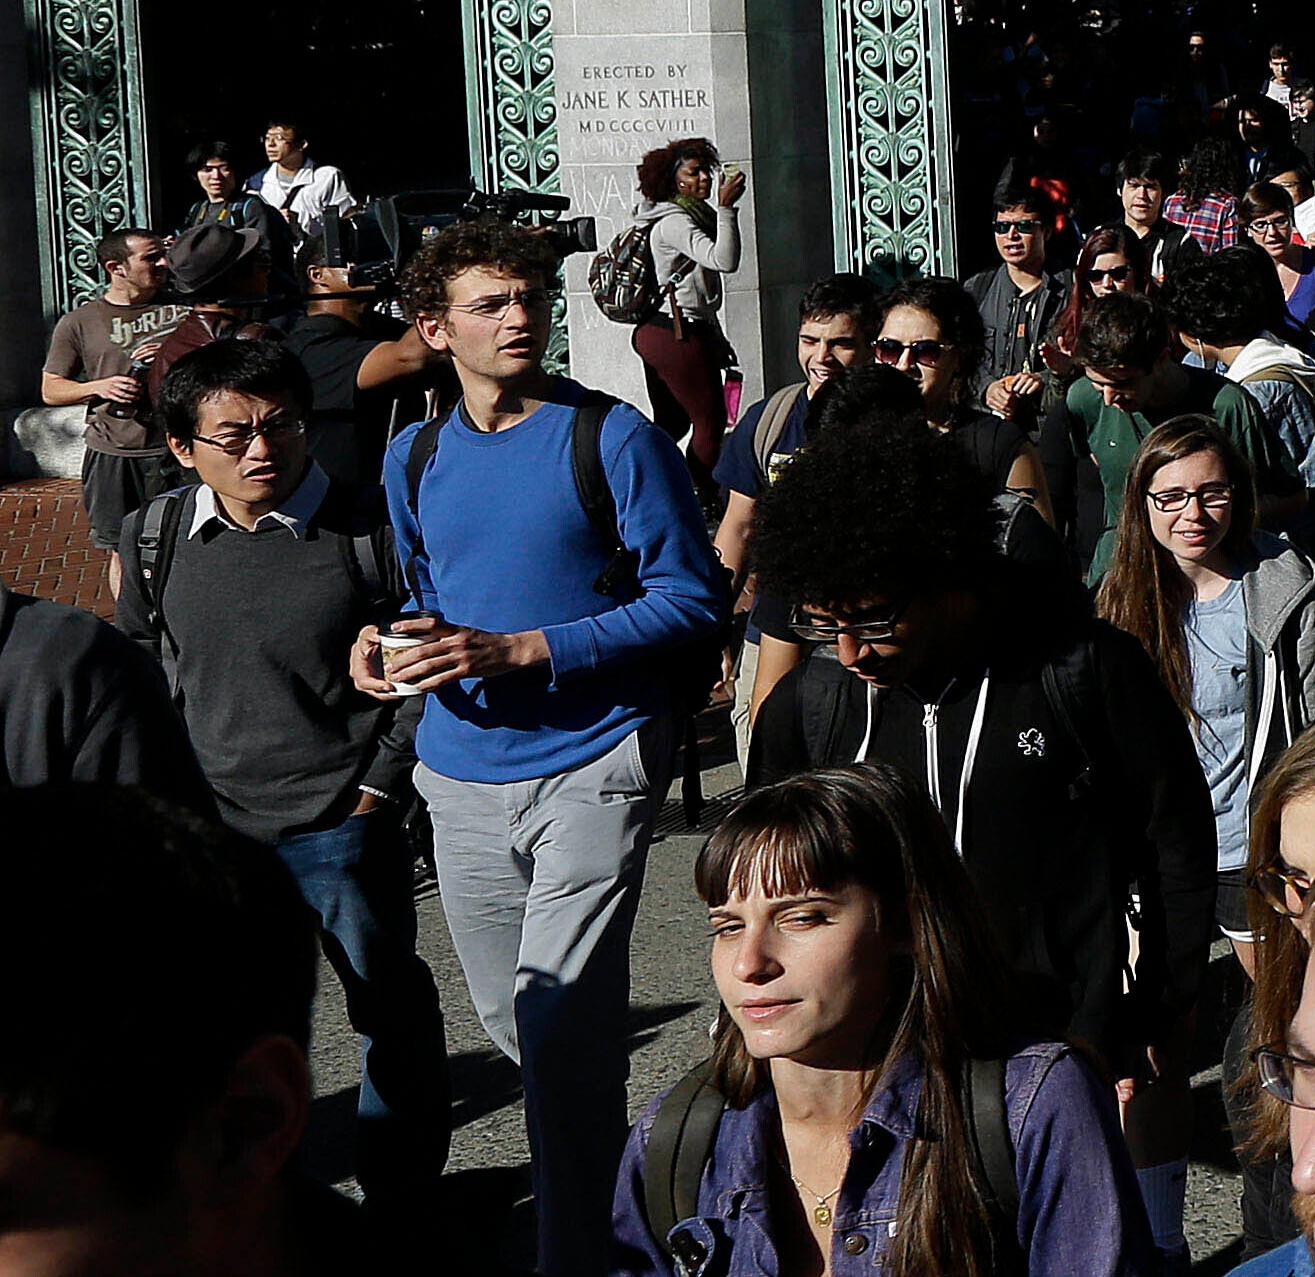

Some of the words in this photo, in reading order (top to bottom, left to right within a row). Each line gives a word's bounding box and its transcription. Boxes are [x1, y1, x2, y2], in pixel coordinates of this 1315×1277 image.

[583, 65, 655, 79] ERECTED
[667, 64, 687, 78] BY
[562, 90, 609, 110] JANE
[617, 90, 631, 109] K
[638, 89, 710, 109] SATHER
